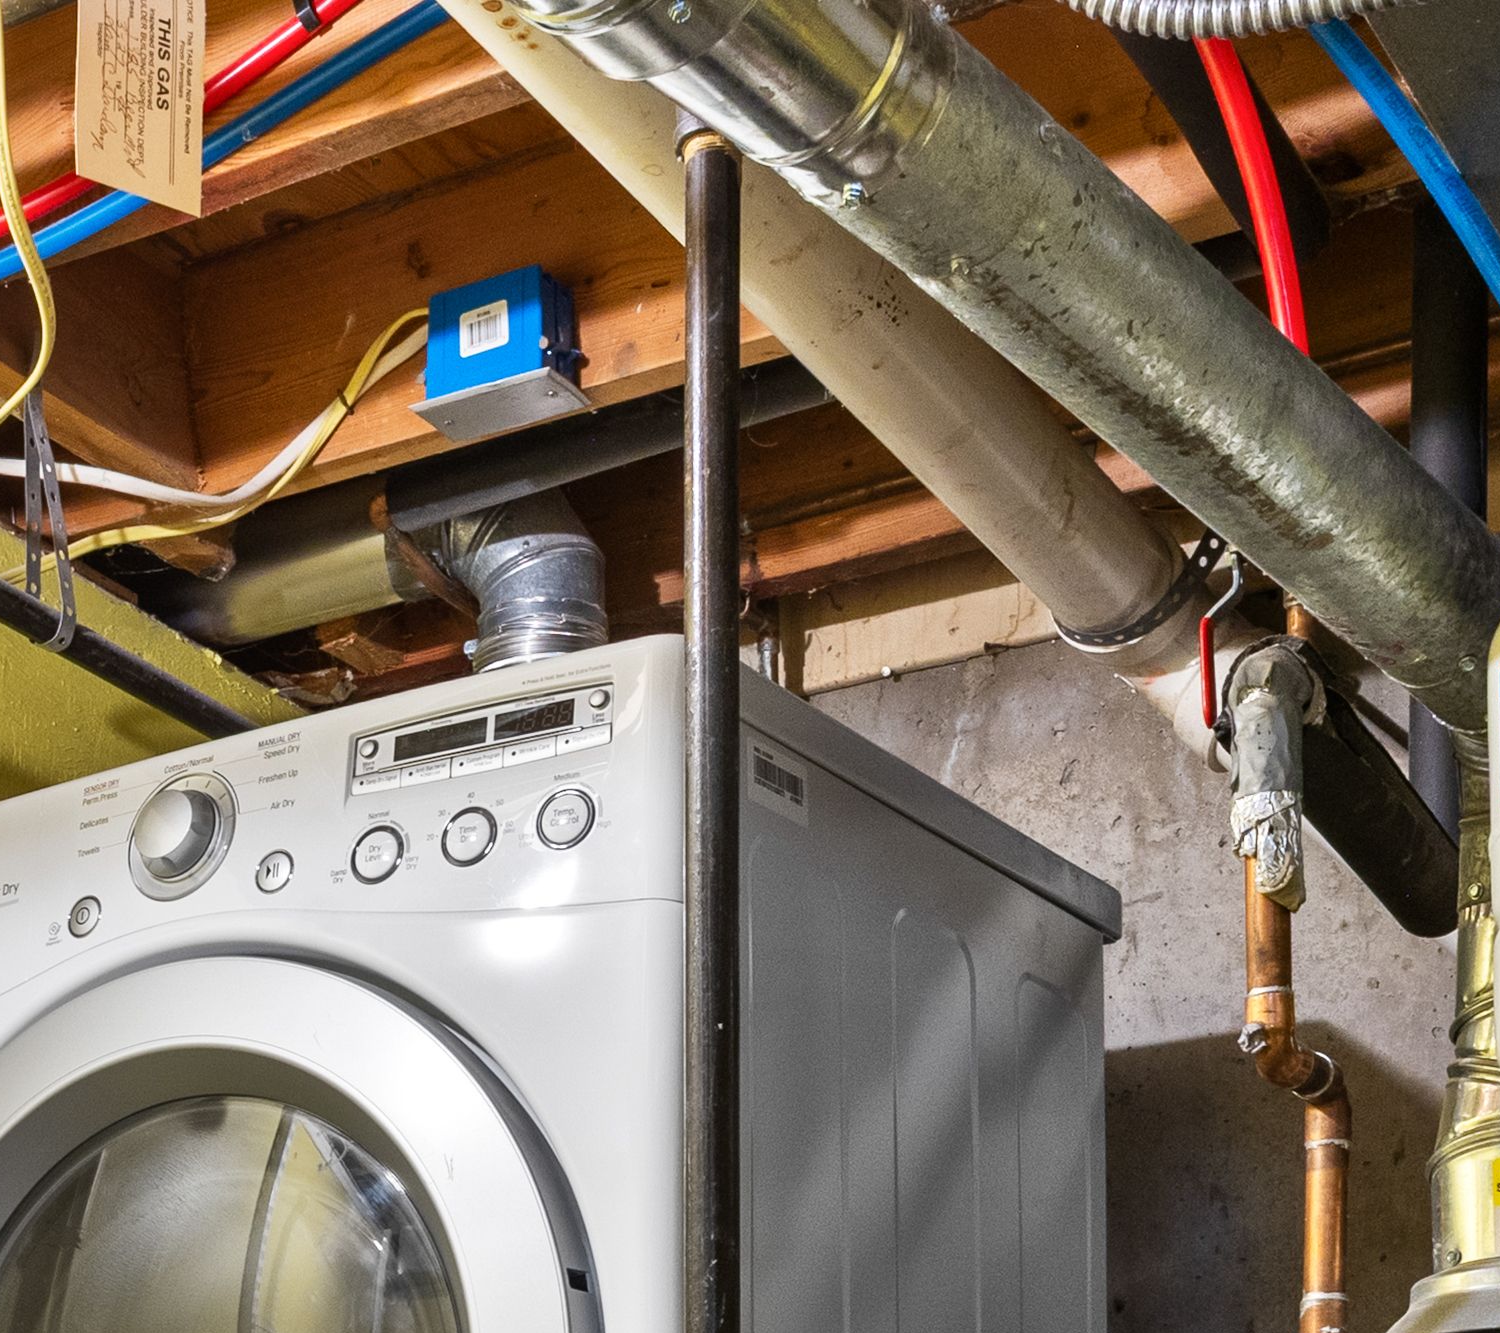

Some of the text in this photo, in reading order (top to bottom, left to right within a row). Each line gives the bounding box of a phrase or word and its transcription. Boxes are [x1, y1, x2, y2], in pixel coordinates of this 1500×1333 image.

[156, 18, 171, 111] THIS GAS
[137, 32, 147, 137] BUILDING INSPECTION
[147, 70, 155, 110] Approved
[258, 734, 285, 748] MANUAL
[264, 744, 300, 761] Speed Dry
[164, 754, 215, 774] Cotton/Normal
[258, 768, 298, 784] Freshen Up
[554, 771, 580, 781] Medium
[79, 816, 109, 830] Delicates
[368, 810, 390, 820] Normal
[78, 845, 100, 858] Towels
[368, 844, 381, 854] Dry
[2, 881, 20, 897] Dry
